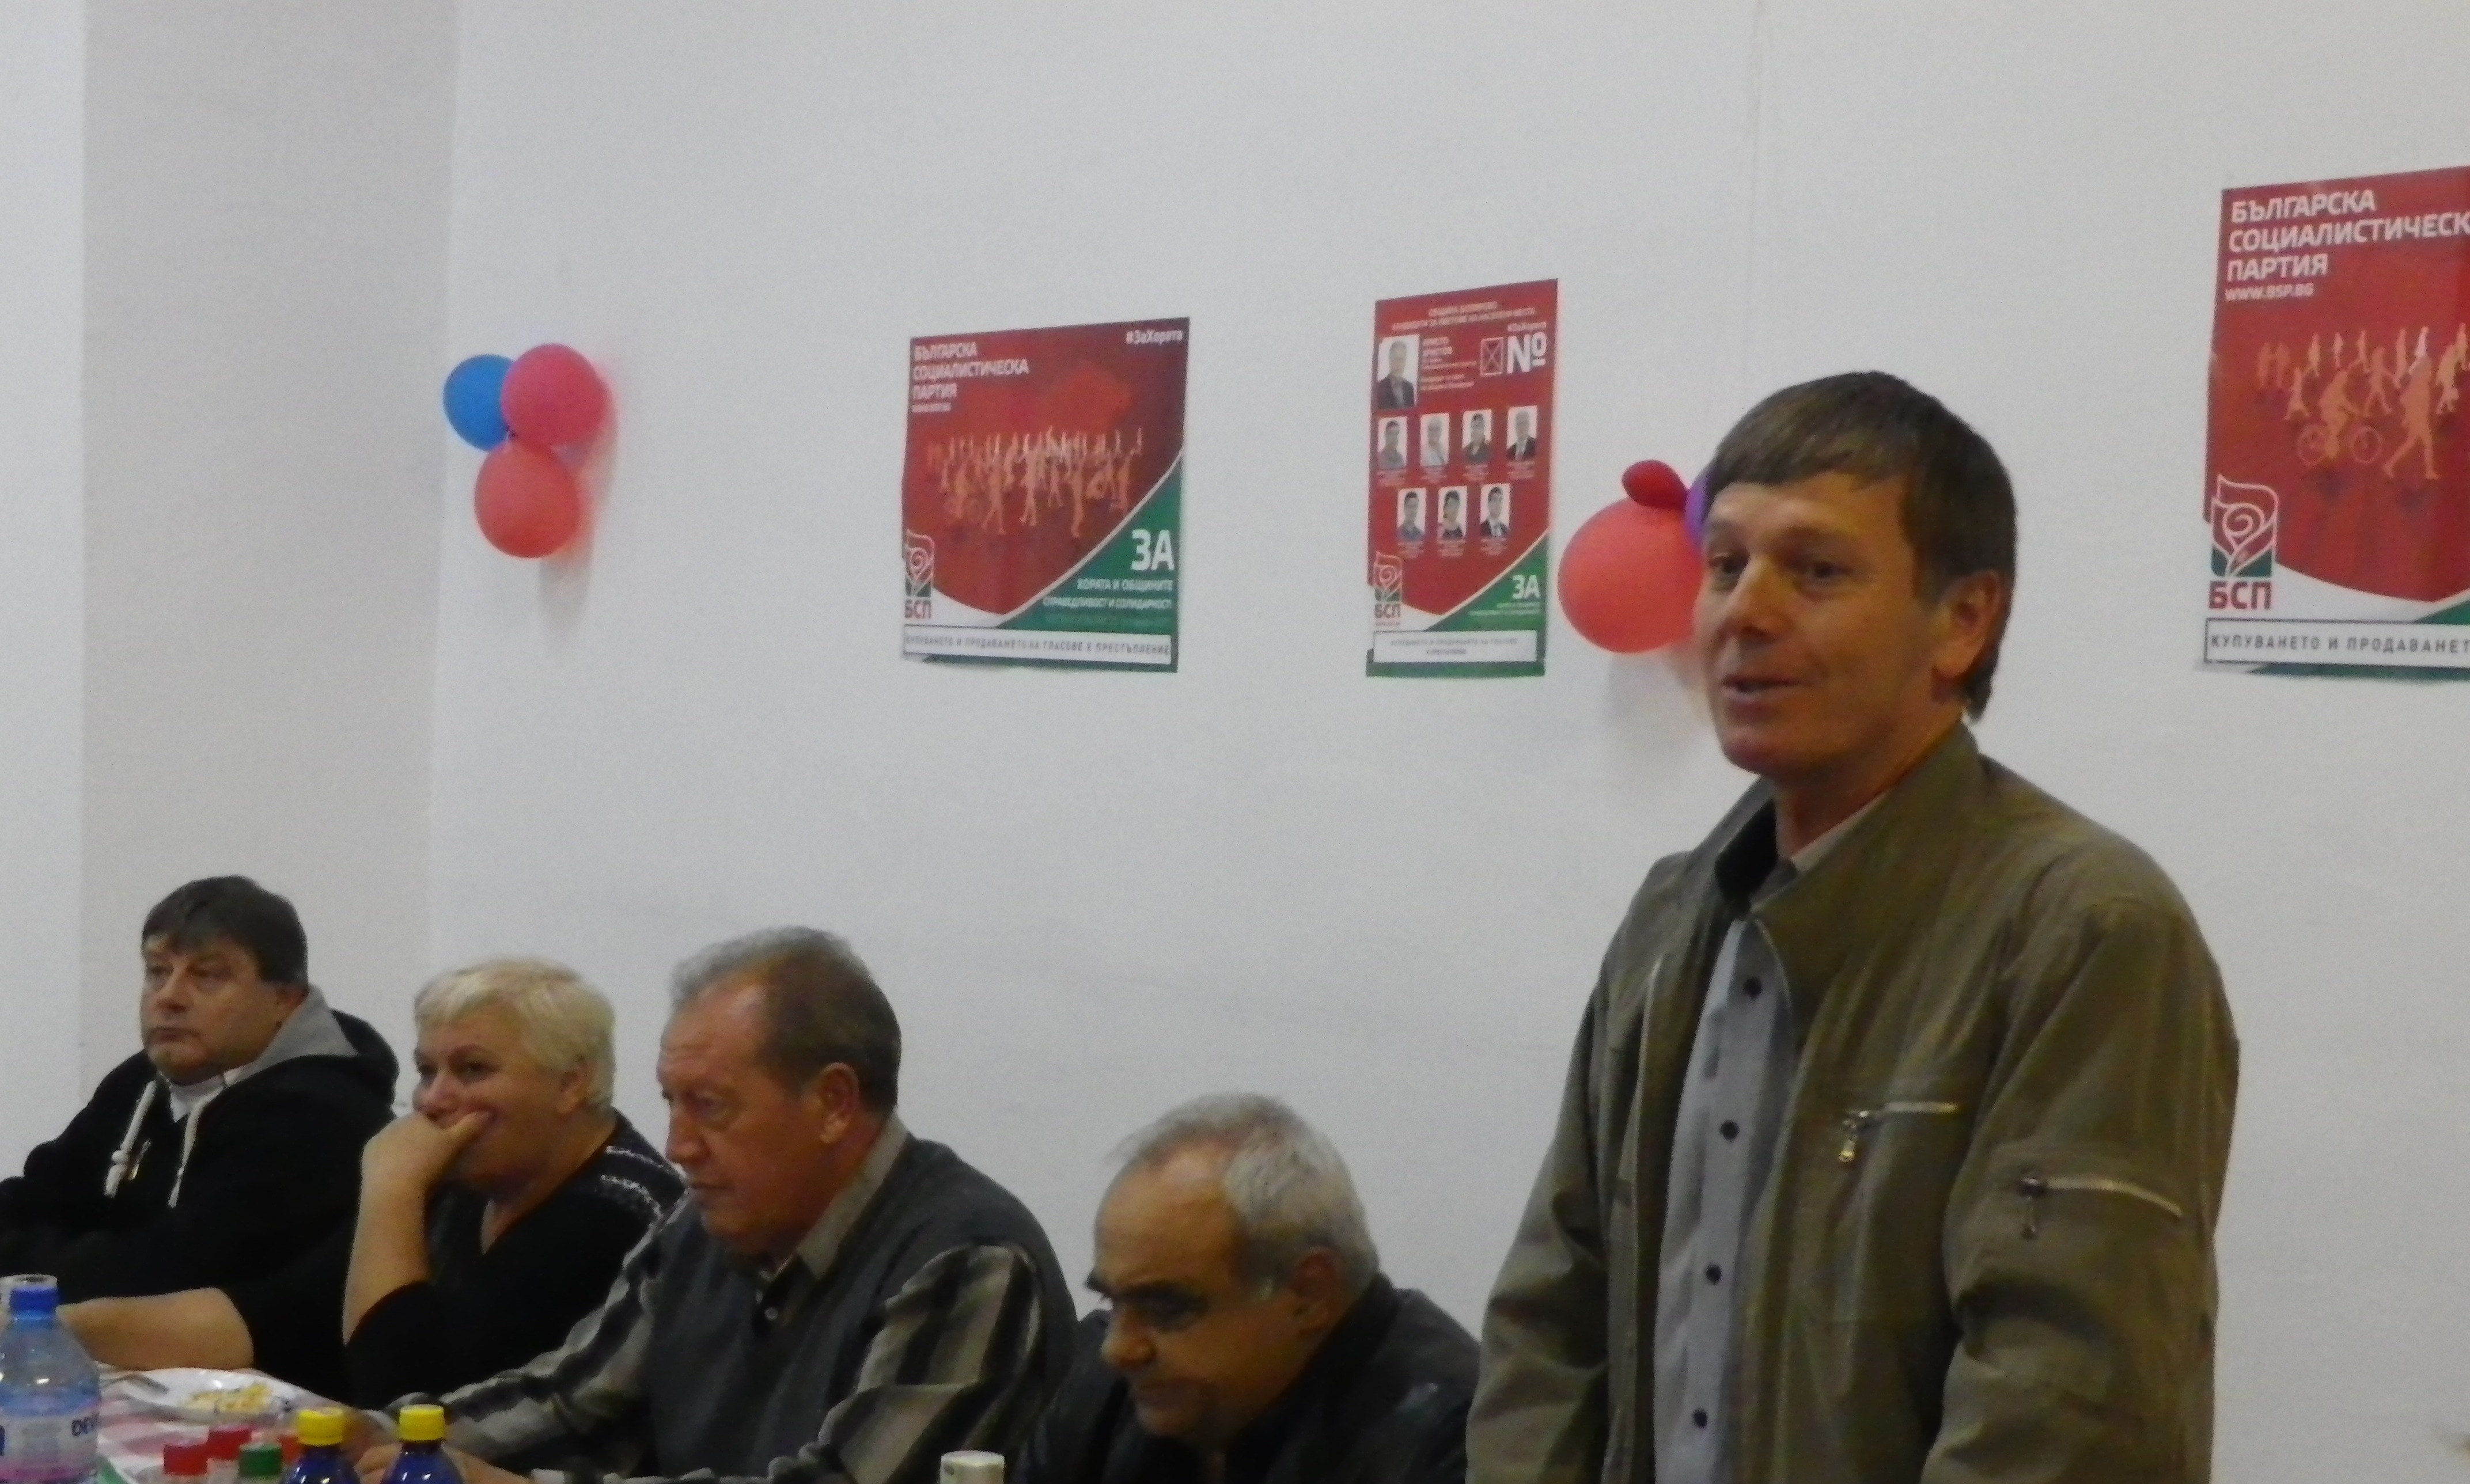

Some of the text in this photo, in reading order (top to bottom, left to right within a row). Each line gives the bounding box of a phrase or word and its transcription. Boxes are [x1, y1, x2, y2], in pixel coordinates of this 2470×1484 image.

[2231, 189, 2377, 223] БЪЛГАРСКА
[2227, 253, 2328, 282] ПАРТИЯ
[1131, 529, 1175, 570] ЗА
[905, 599, 931, 619] БСП
[2208, 580, 2272, 610] БСП
[1375, 602, 1401, 618] БСП
[2211, 634, 2320, 649] КУПУВАНЕТО
[2328, 637, 2339, 649] И
